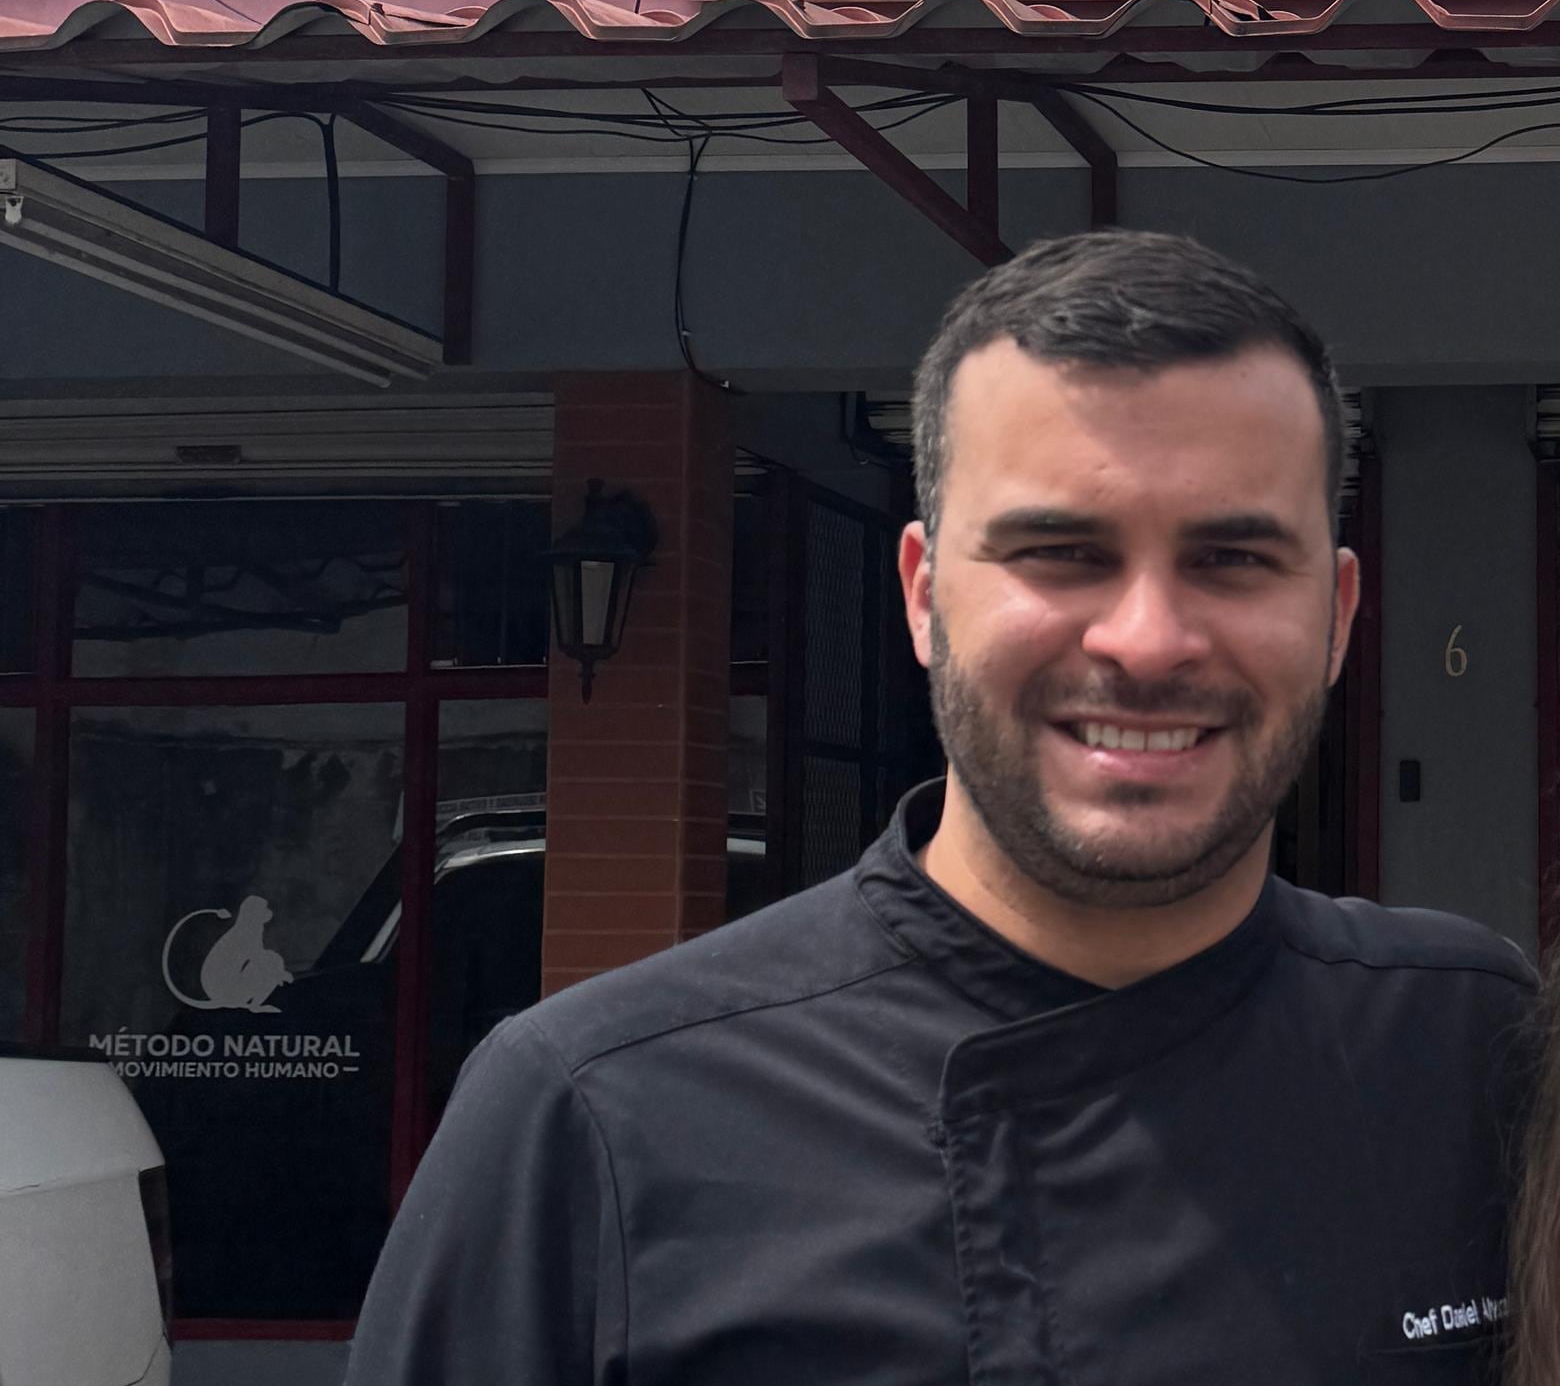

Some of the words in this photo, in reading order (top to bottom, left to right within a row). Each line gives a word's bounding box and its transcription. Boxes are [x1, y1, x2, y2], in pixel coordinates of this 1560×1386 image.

[1445, 625, 1469, 678] 6
[89, 1027, 215, 1057] MÉTODO
[224, 1035, 360, 1057] NATURAL
[244, 1062, 339, 1079] HUMANO
[1403, 1307, 1438, 1339] Chef
